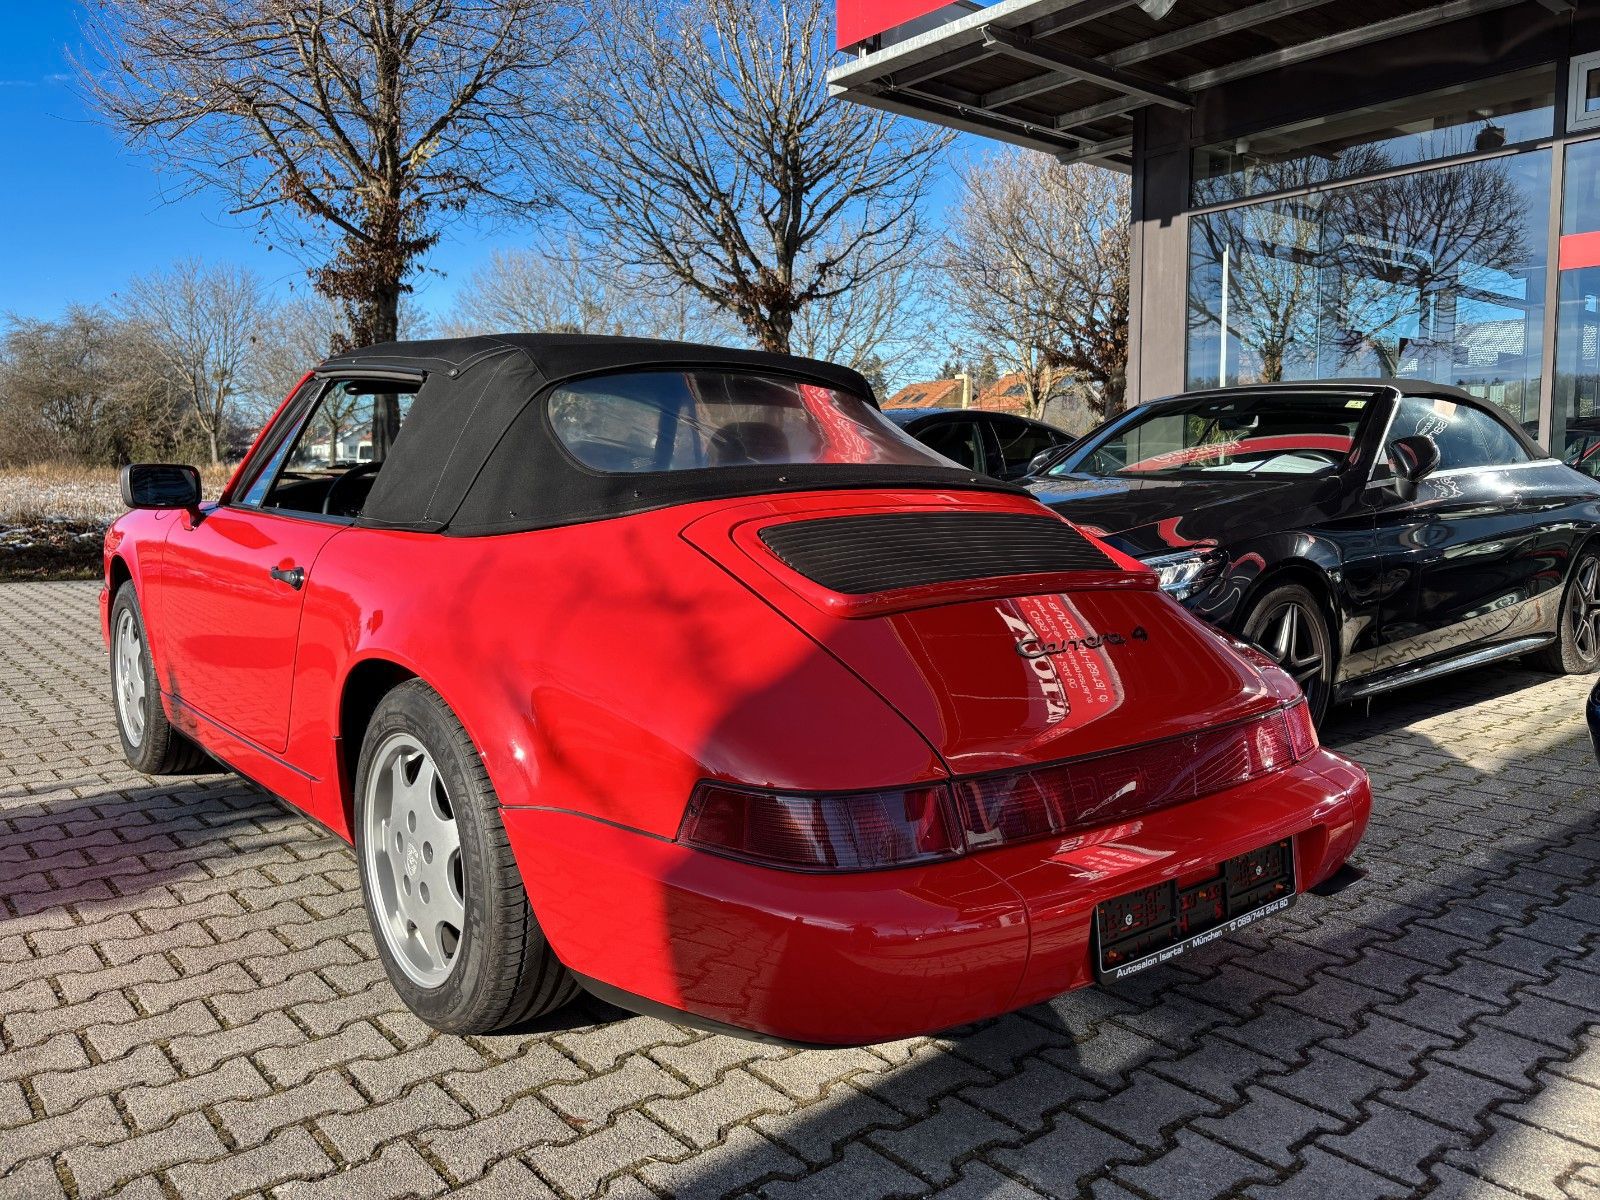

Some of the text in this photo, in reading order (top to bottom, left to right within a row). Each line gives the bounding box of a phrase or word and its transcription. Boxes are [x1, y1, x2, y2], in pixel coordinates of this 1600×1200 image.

[1015, 625, 1148, 659] Carrera 4
[1116, 957, 1158, 978] Autosalon
[1159, 945, 1184, 962] Isartal
[1192, 929, 1223, 948] München
